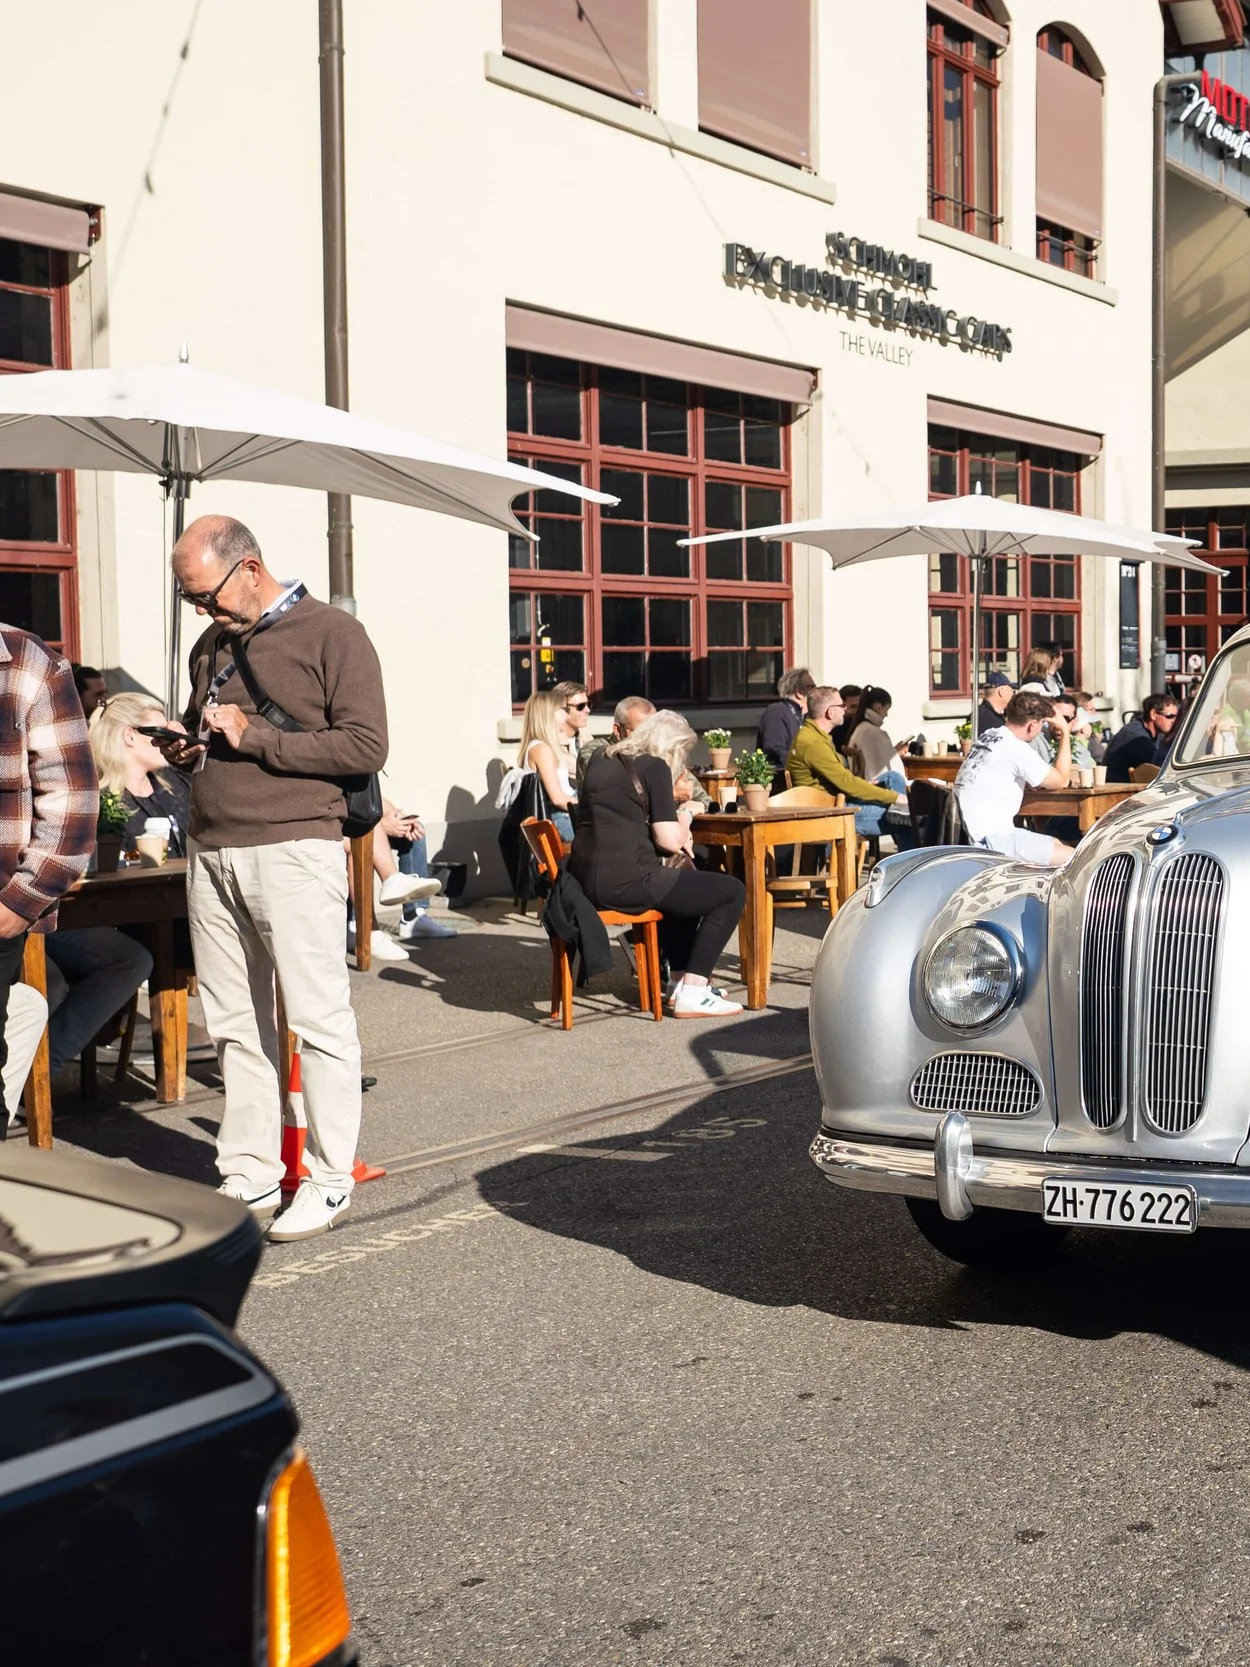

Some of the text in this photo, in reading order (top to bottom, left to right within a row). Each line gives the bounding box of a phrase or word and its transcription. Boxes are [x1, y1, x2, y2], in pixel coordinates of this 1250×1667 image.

[722, 242, 1013, 354] EXCLUSIVE CLASSIC CARS
[839, 330, 914, 367] THE VALLEY
